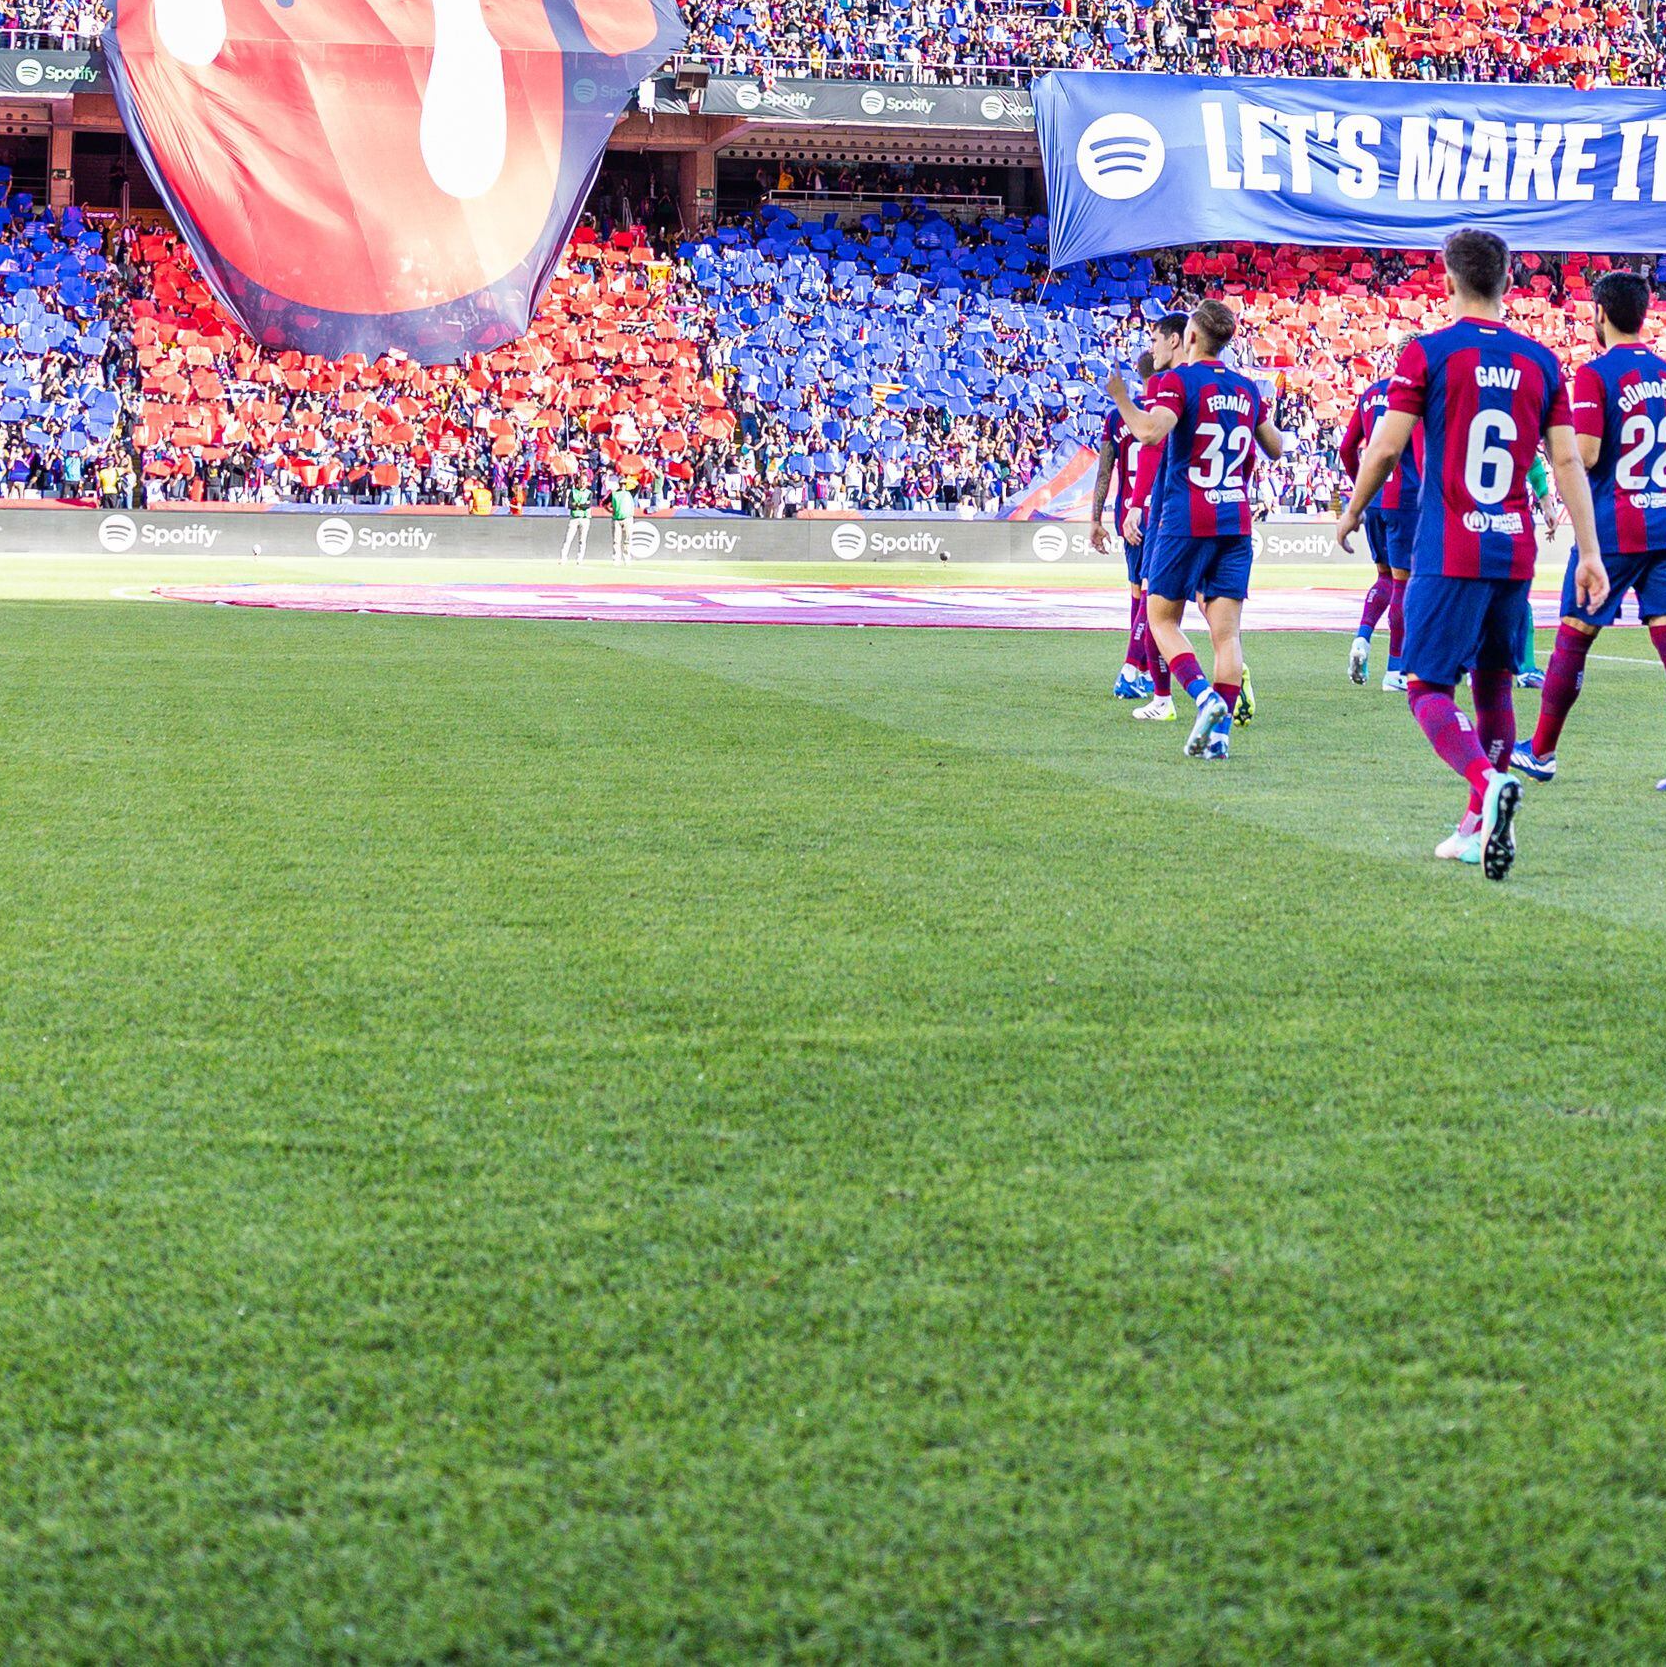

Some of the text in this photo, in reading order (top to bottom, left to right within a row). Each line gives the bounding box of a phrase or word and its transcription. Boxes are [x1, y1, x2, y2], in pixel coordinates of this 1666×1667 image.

[45, 65, 97, 83] Spotify
[761, 91, 813, 110] Spotify
[886, 97, 935, 114] Spotify
[1200, 102, 1382, 200] LET'S
[1397, 116, 1603, 201] MAKE
[1475, 365, 1521, 390] GAVI
[1206, 393, 1251, 417] FERMÍN
[1188, 422, 1252, 488] 32
[1464, 408, 1518, 505] 6
[141, 523, 218, 548] Spotify
[358, 527, 434, 552] Spotify
[663, 530, 739, 554] Spotify
[870, 531, 942, 556] Spotify
[1267, 536, 1335, 557] Spotify
